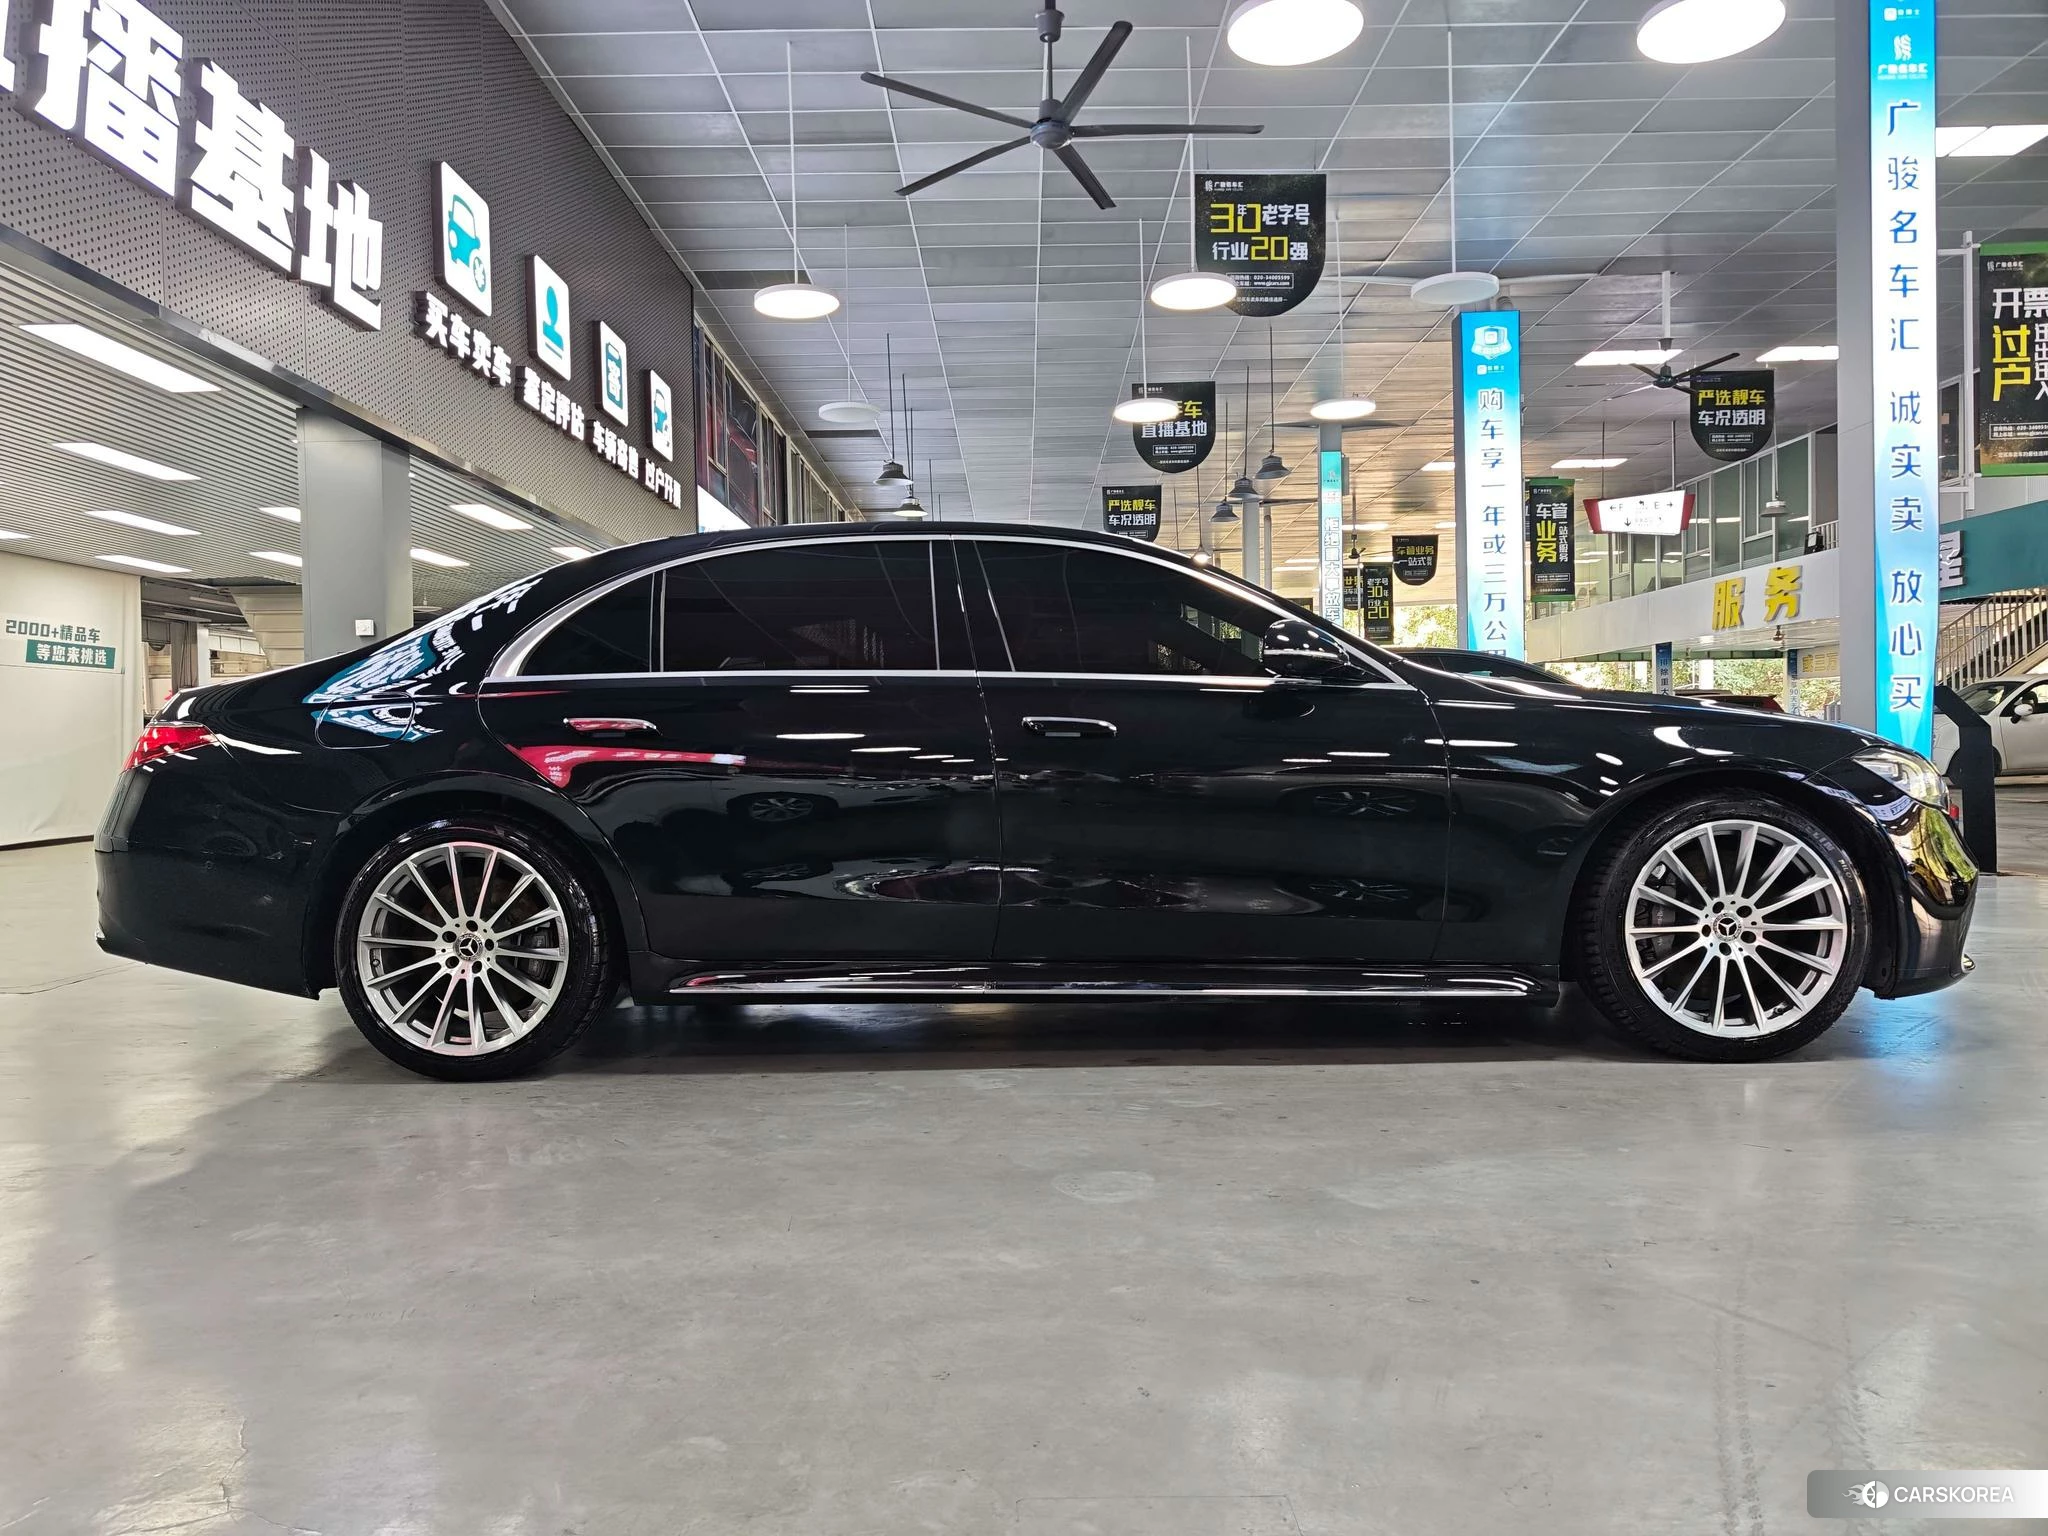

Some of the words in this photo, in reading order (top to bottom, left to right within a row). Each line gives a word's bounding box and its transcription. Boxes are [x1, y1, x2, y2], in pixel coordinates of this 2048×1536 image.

[0, 0, 383, 331] 播基地
[1887, 101, 1920, 352] 广骏名车汇
[1212, 236, 1308, 260] 行业20强
[1993, 324, 2031, 401] 过户
[1698, 389, 1766, 406] 严选靓车
[1141, 420, 1208, 438] 直播基地
[1698, 408, 1766, 426] 车况透明
[1889, 391, 1922, 532] 诚实卖
[1108, 499, 1156, 511] 严选靓车
[1536, 503, 1568, 519] 车管
[1108, 513, 1156, 526] 车况透明
[1536, 520, 1557, 563] 业务
[1712, 565, 1803, 631] 服务
[6, 619, 101, 643] 2000+精品车
[1889, 570, 1923, 711] 放心买
[36, 643, 107, 666] 等您来挑选
